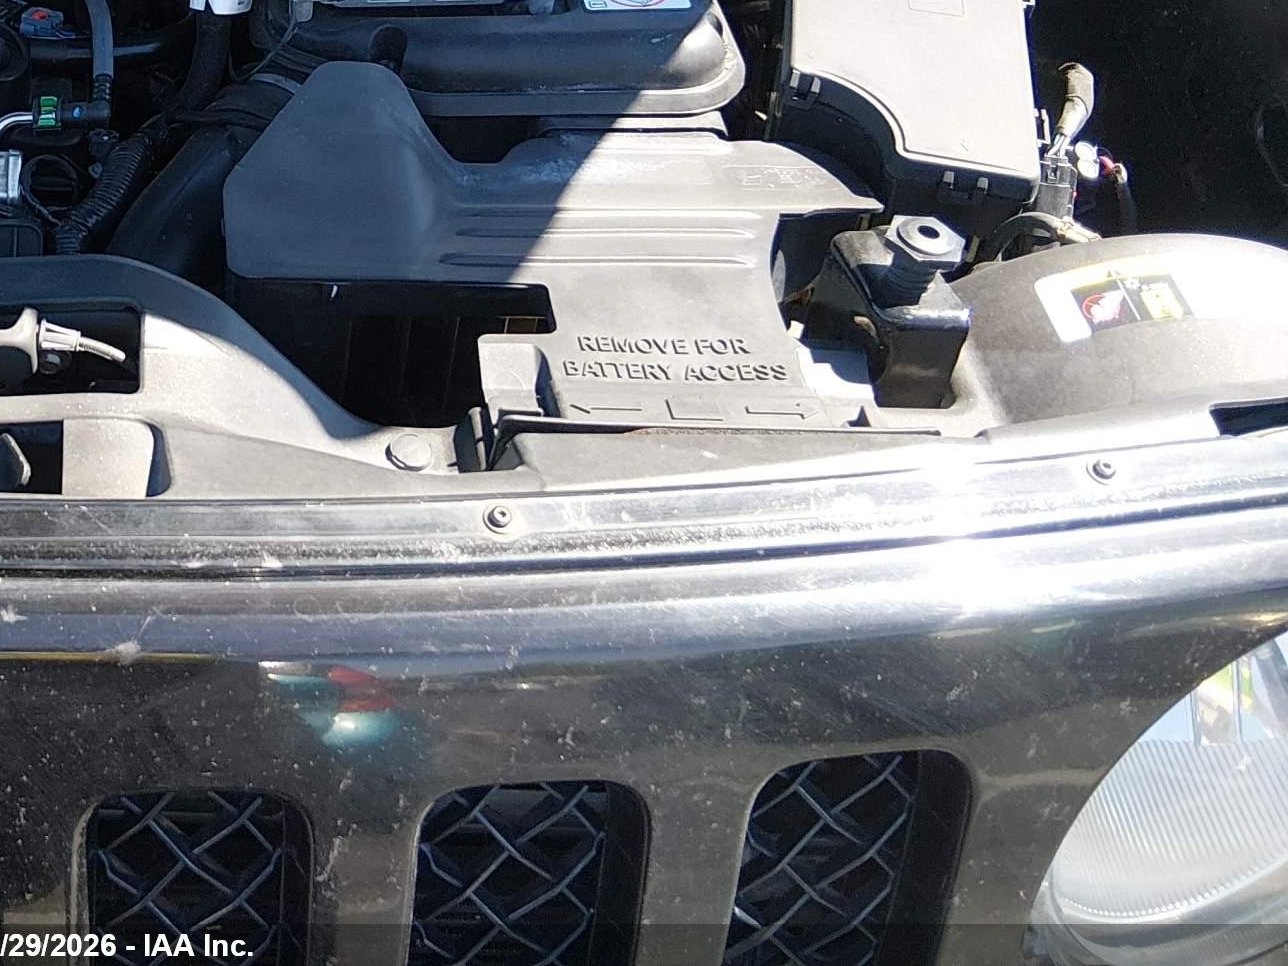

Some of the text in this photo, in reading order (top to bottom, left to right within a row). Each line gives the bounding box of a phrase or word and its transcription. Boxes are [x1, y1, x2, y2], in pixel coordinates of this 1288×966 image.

[577, 336, 751, 355] REMOVE FOR
[562, 360, 789, 382] BATTERY ACCESS
